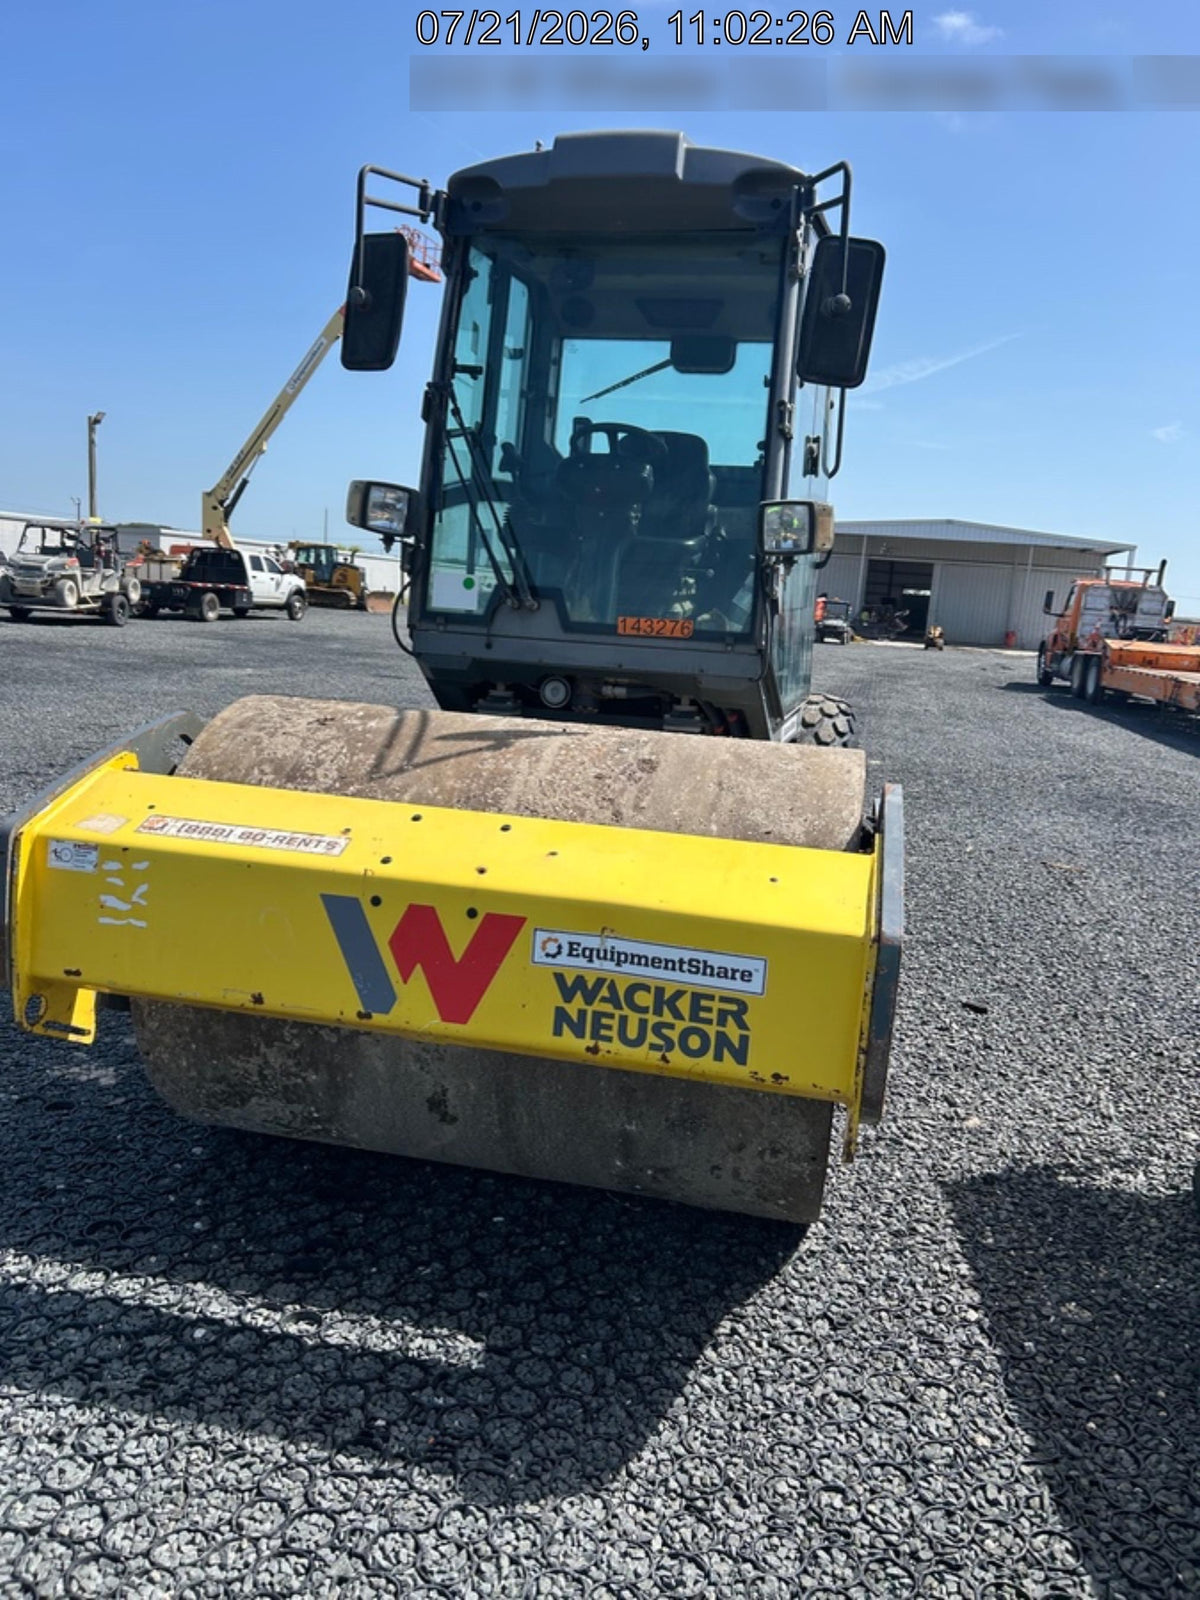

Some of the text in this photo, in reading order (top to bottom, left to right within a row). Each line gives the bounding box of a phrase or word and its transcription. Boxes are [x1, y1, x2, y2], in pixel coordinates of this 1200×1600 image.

[620, 618, 692, 637] 143276
[567, 941, 753, 982] EquipmentShare
[553, 972, 751, 1031] WACKER
[553, 1006, 749, 1066] NEUSON
